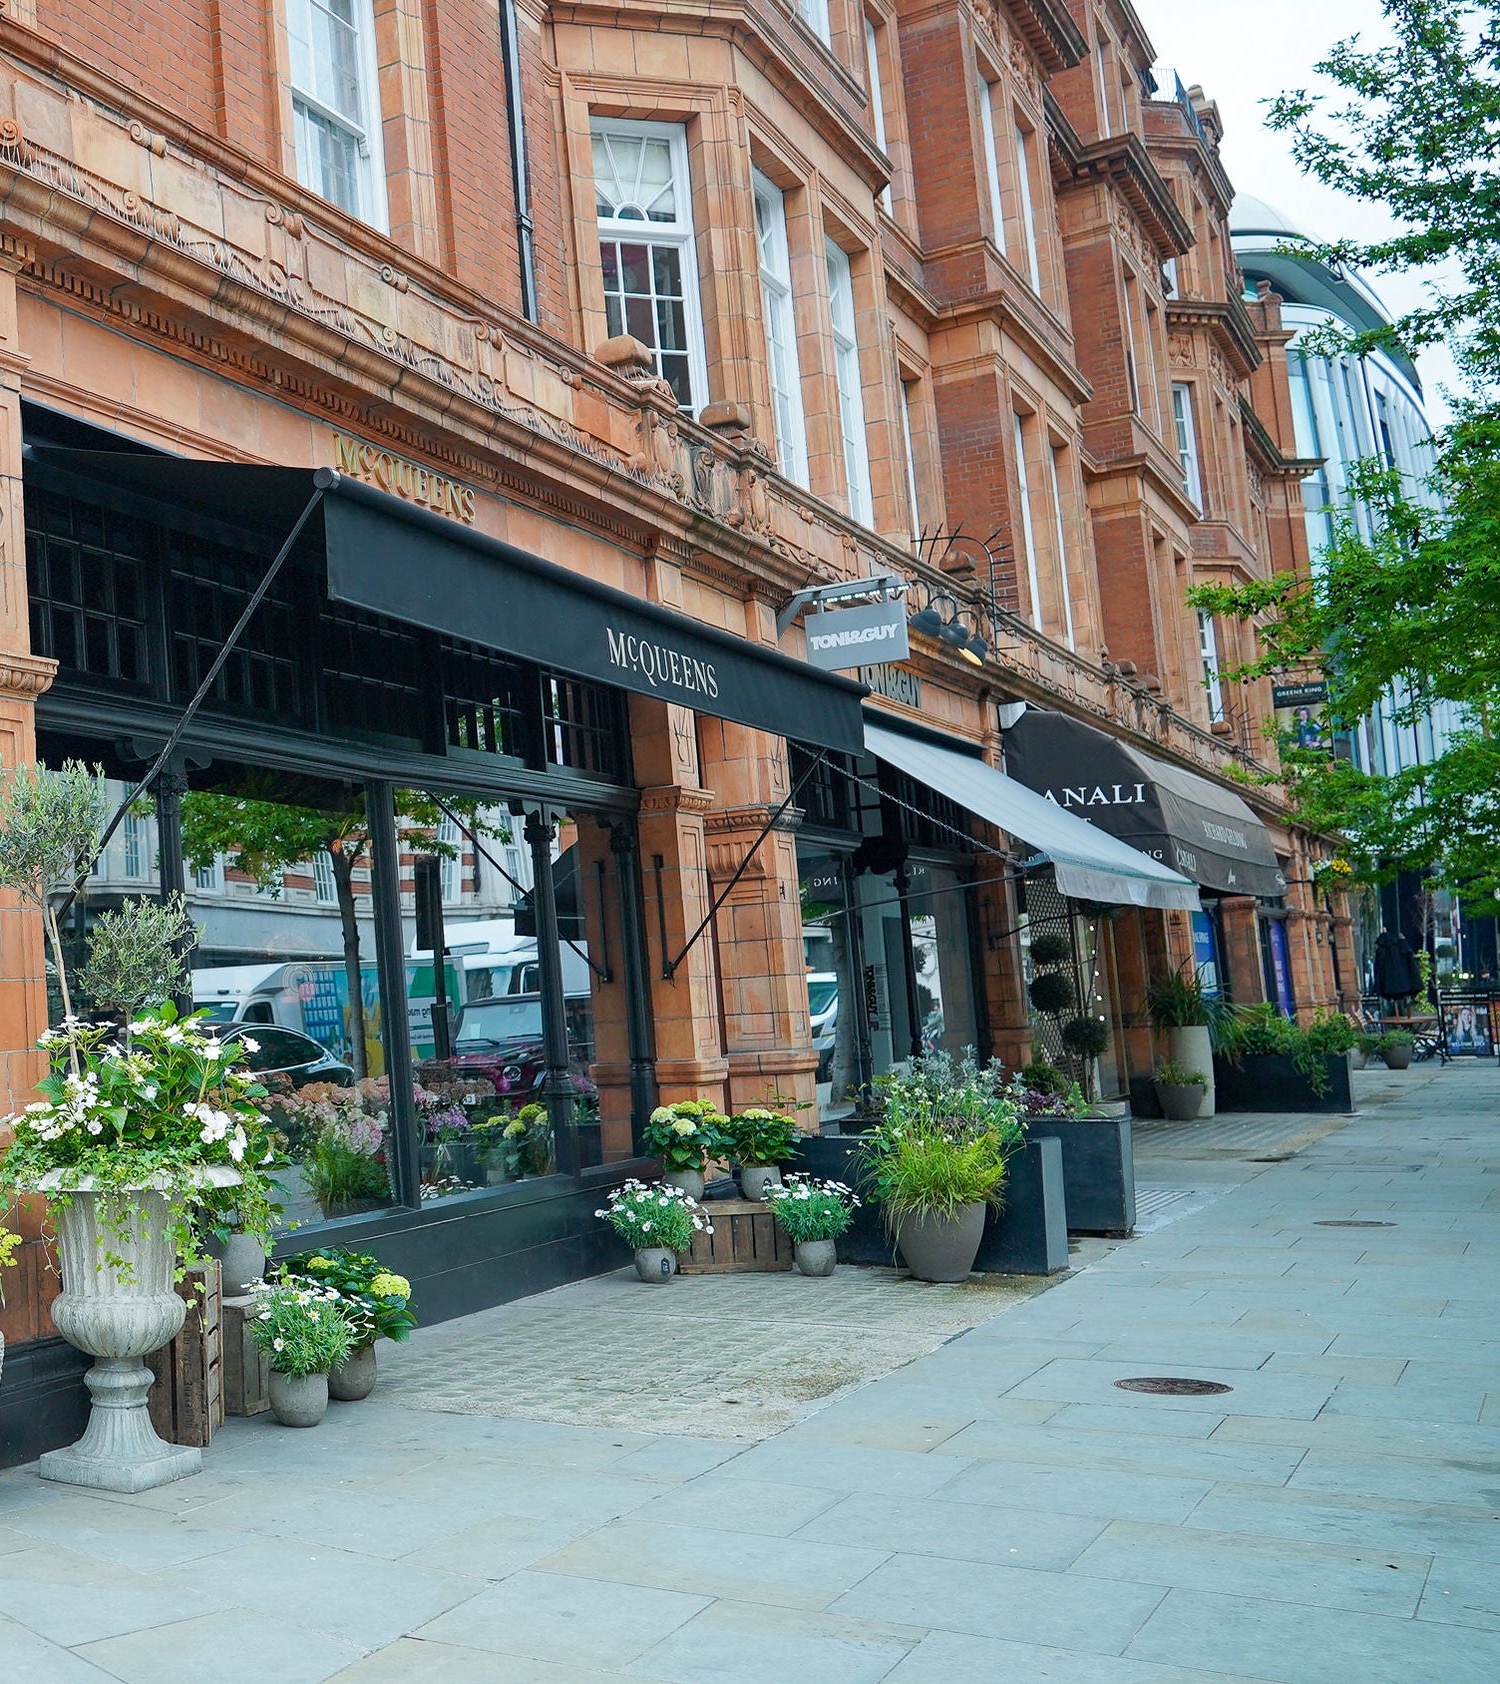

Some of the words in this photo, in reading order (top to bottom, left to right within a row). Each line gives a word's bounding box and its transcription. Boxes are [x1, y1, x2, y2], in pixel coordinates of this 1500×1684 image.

[810, 622, 900, 650] TONI&GUY
[1276, 689, 1303, 697] GREENE
[1304, 686, 1322, 694] KING
[1043, 783, 1146, 807] ANALI
